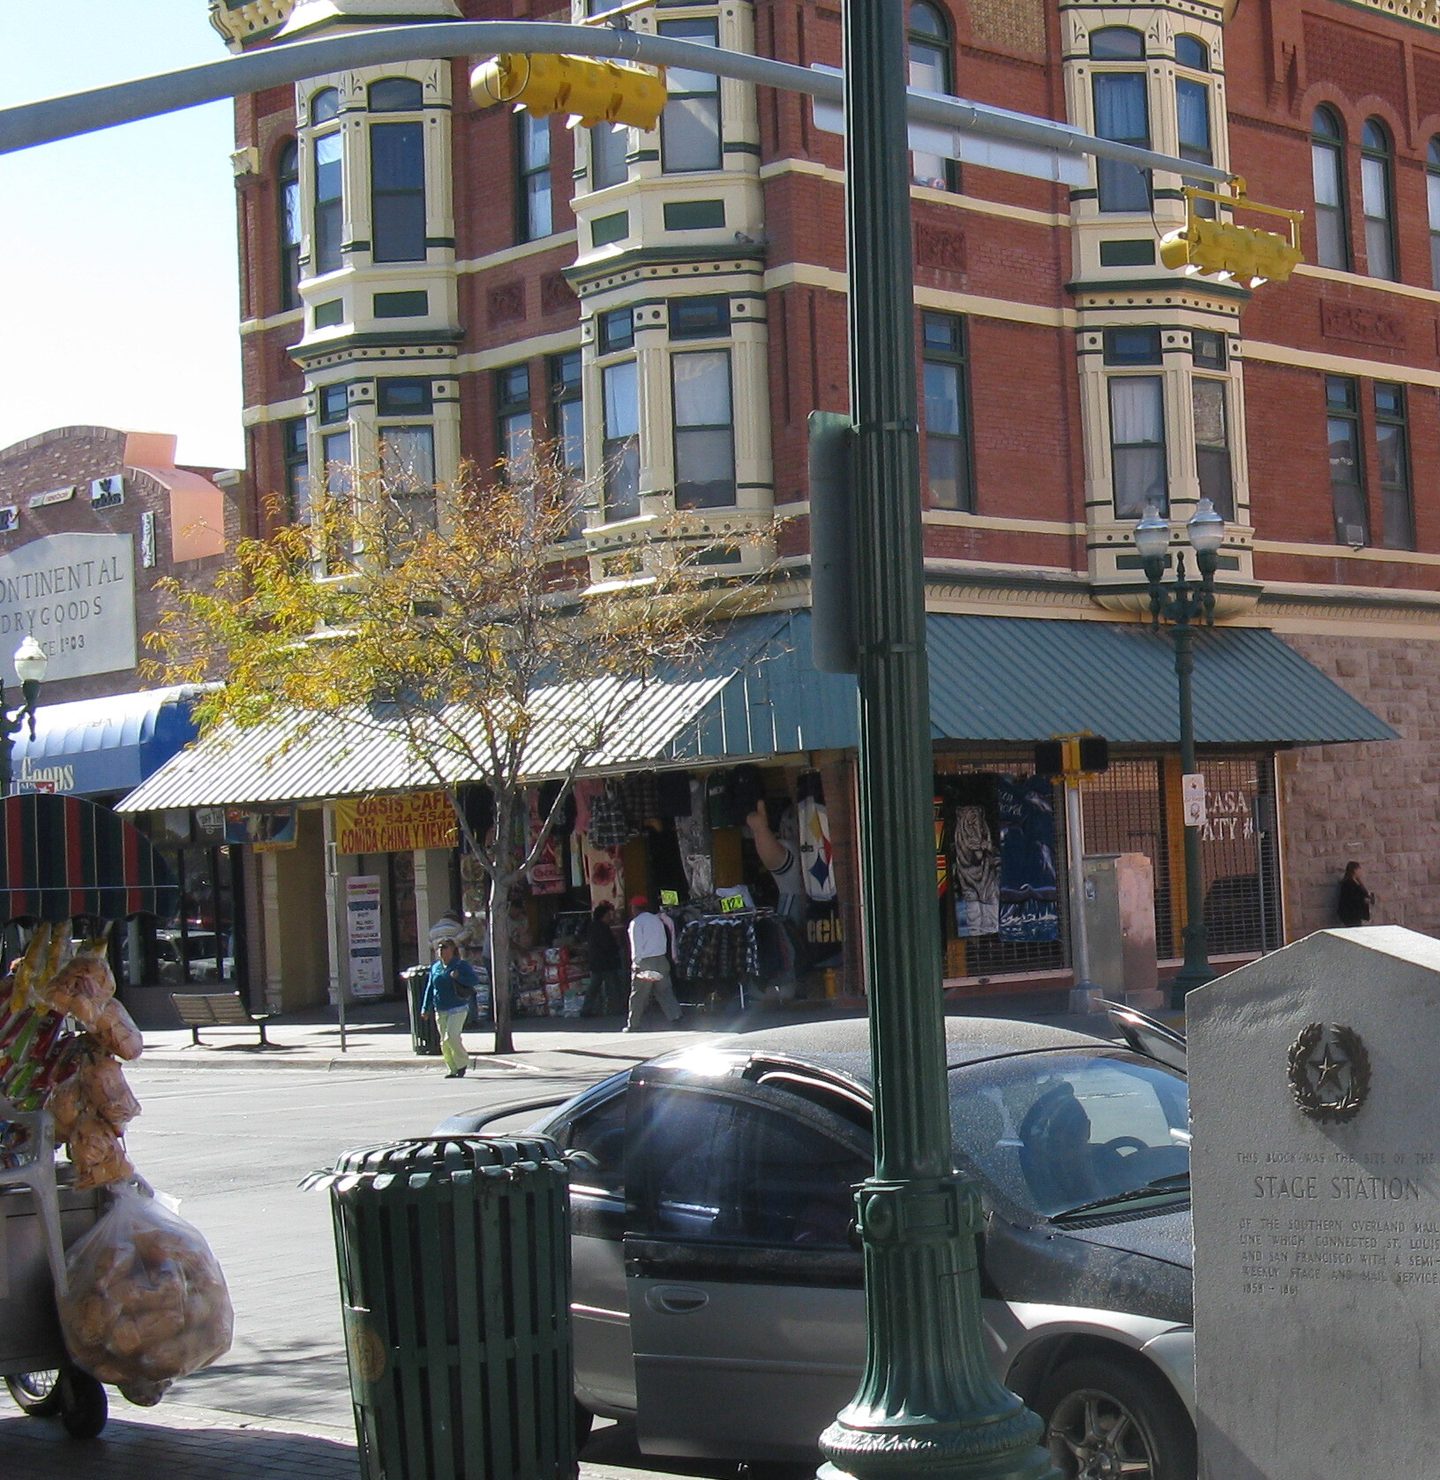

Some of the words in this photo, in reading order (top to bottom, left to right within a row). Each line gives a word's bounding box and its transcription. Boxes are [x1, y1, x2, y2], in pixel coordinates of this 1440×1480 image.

[356, 798, 403, 816] OASIS
[381, 824, 411, 850] CHINA
[1198, 818, 1238, 840] ATY
[1237, 1152, 1258, 1164] THIS
[1266, 1152, 1296, 1164] BLOCK
[1303, 1152, 1324, 1164] WAS
[1336, 1152, 1355, 1164] THE
[1364, 1152, 1385, 1164] SITE
[1394, 1153, 1405, 1164] OF
[1416, 1153, 1434, 1164] THE
[1255, 1176, 1318, 1199] STAGE
[1332, 1176, 1420, 1200] STATION
[1239, 1217, 1252, 1230] OF
[1260, 1218, 1280, 1230] THE
[1288, 1218, 1343, 1231] SOUTHERN
[1351, 1220, 1405, 1233] OVERLAND
[1415, 1221, 1440, 1234] MAIL
[1239, 1233, 1262, 1246] LINE
[1271, 1234, 1305, 1246] WHICH
[1315, 1235, 1377, 1248] CONNECTED
[1410, 1238, 1440, 1250] LOUIS
[1242, 1250, 1263, 1262] AND
[1269, 1251, 1288, 1263] SAN
[1296, 1252, 1352, 1264] FRANCISCO
[1360, 1254, 1386, 1266] WITH
[1394, 1255, 1401, 1266] A
[1409, 1255, 1440, 1267] SEMI-
[1242, 1265, 1280, 1277] WEEKLY
[1290, 1267, 1320, 1280] STAGE
[1331, 1269, 1352, 1281] AND
[1361, 1271, 1387, 1282] MAIL
